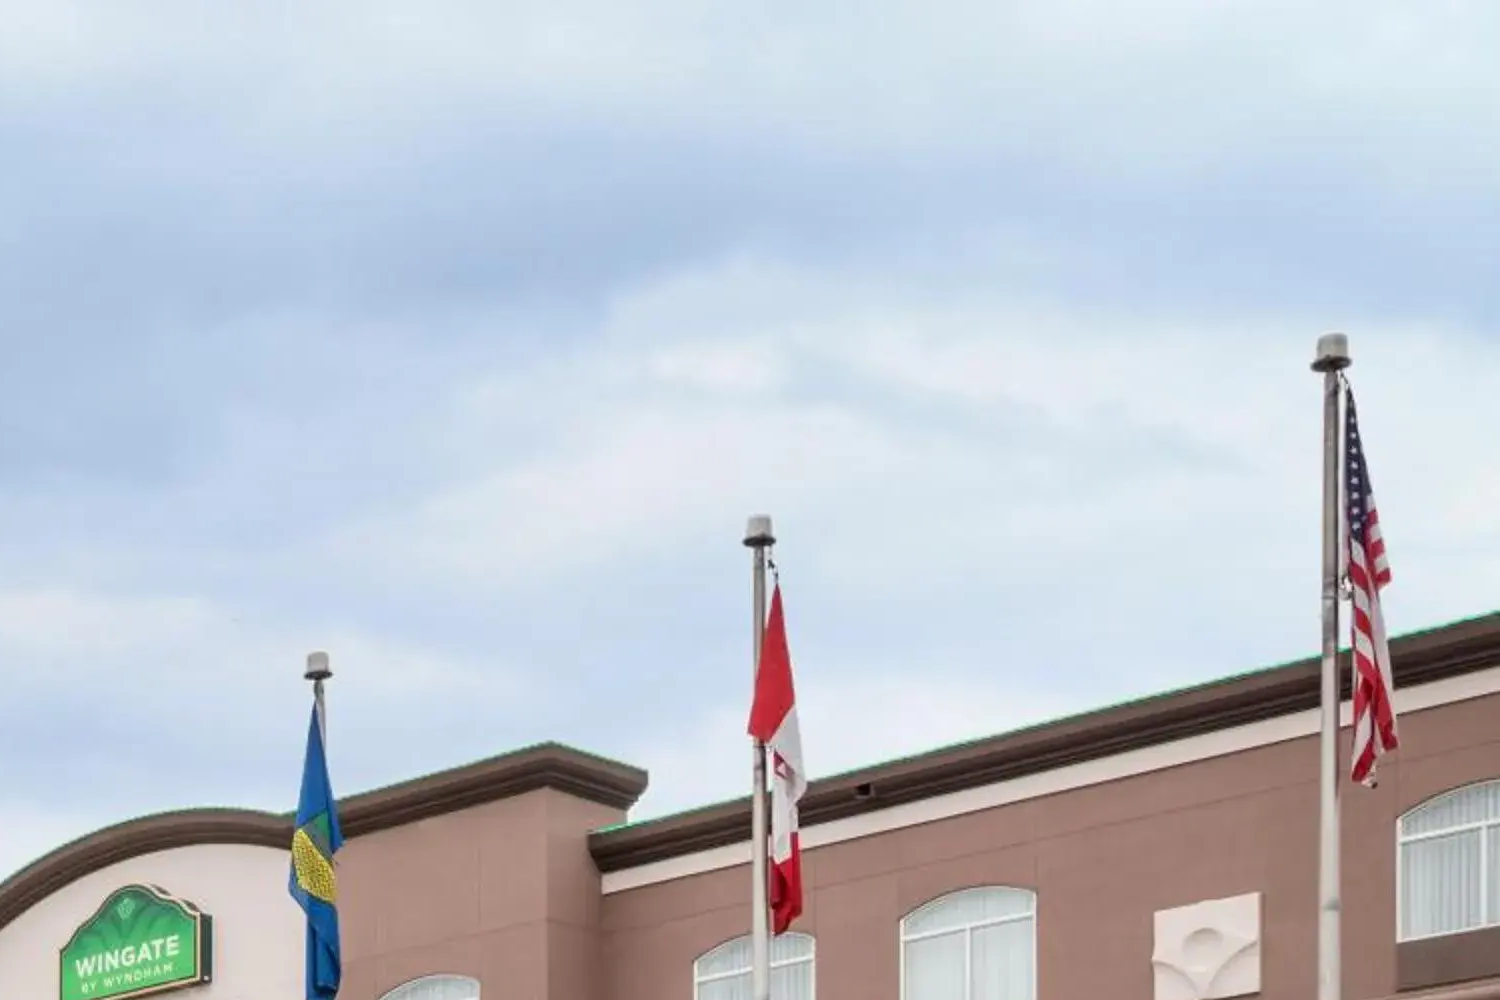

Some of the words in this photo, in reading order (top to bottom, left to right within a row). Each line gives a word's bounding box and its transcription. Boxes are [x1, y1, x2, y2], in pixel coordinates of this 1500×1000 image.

[75, 934, 181, 978] WINGATE
[81, 982, 98, 995] BY
[103, 962, 174, 988] WYNDHAM
